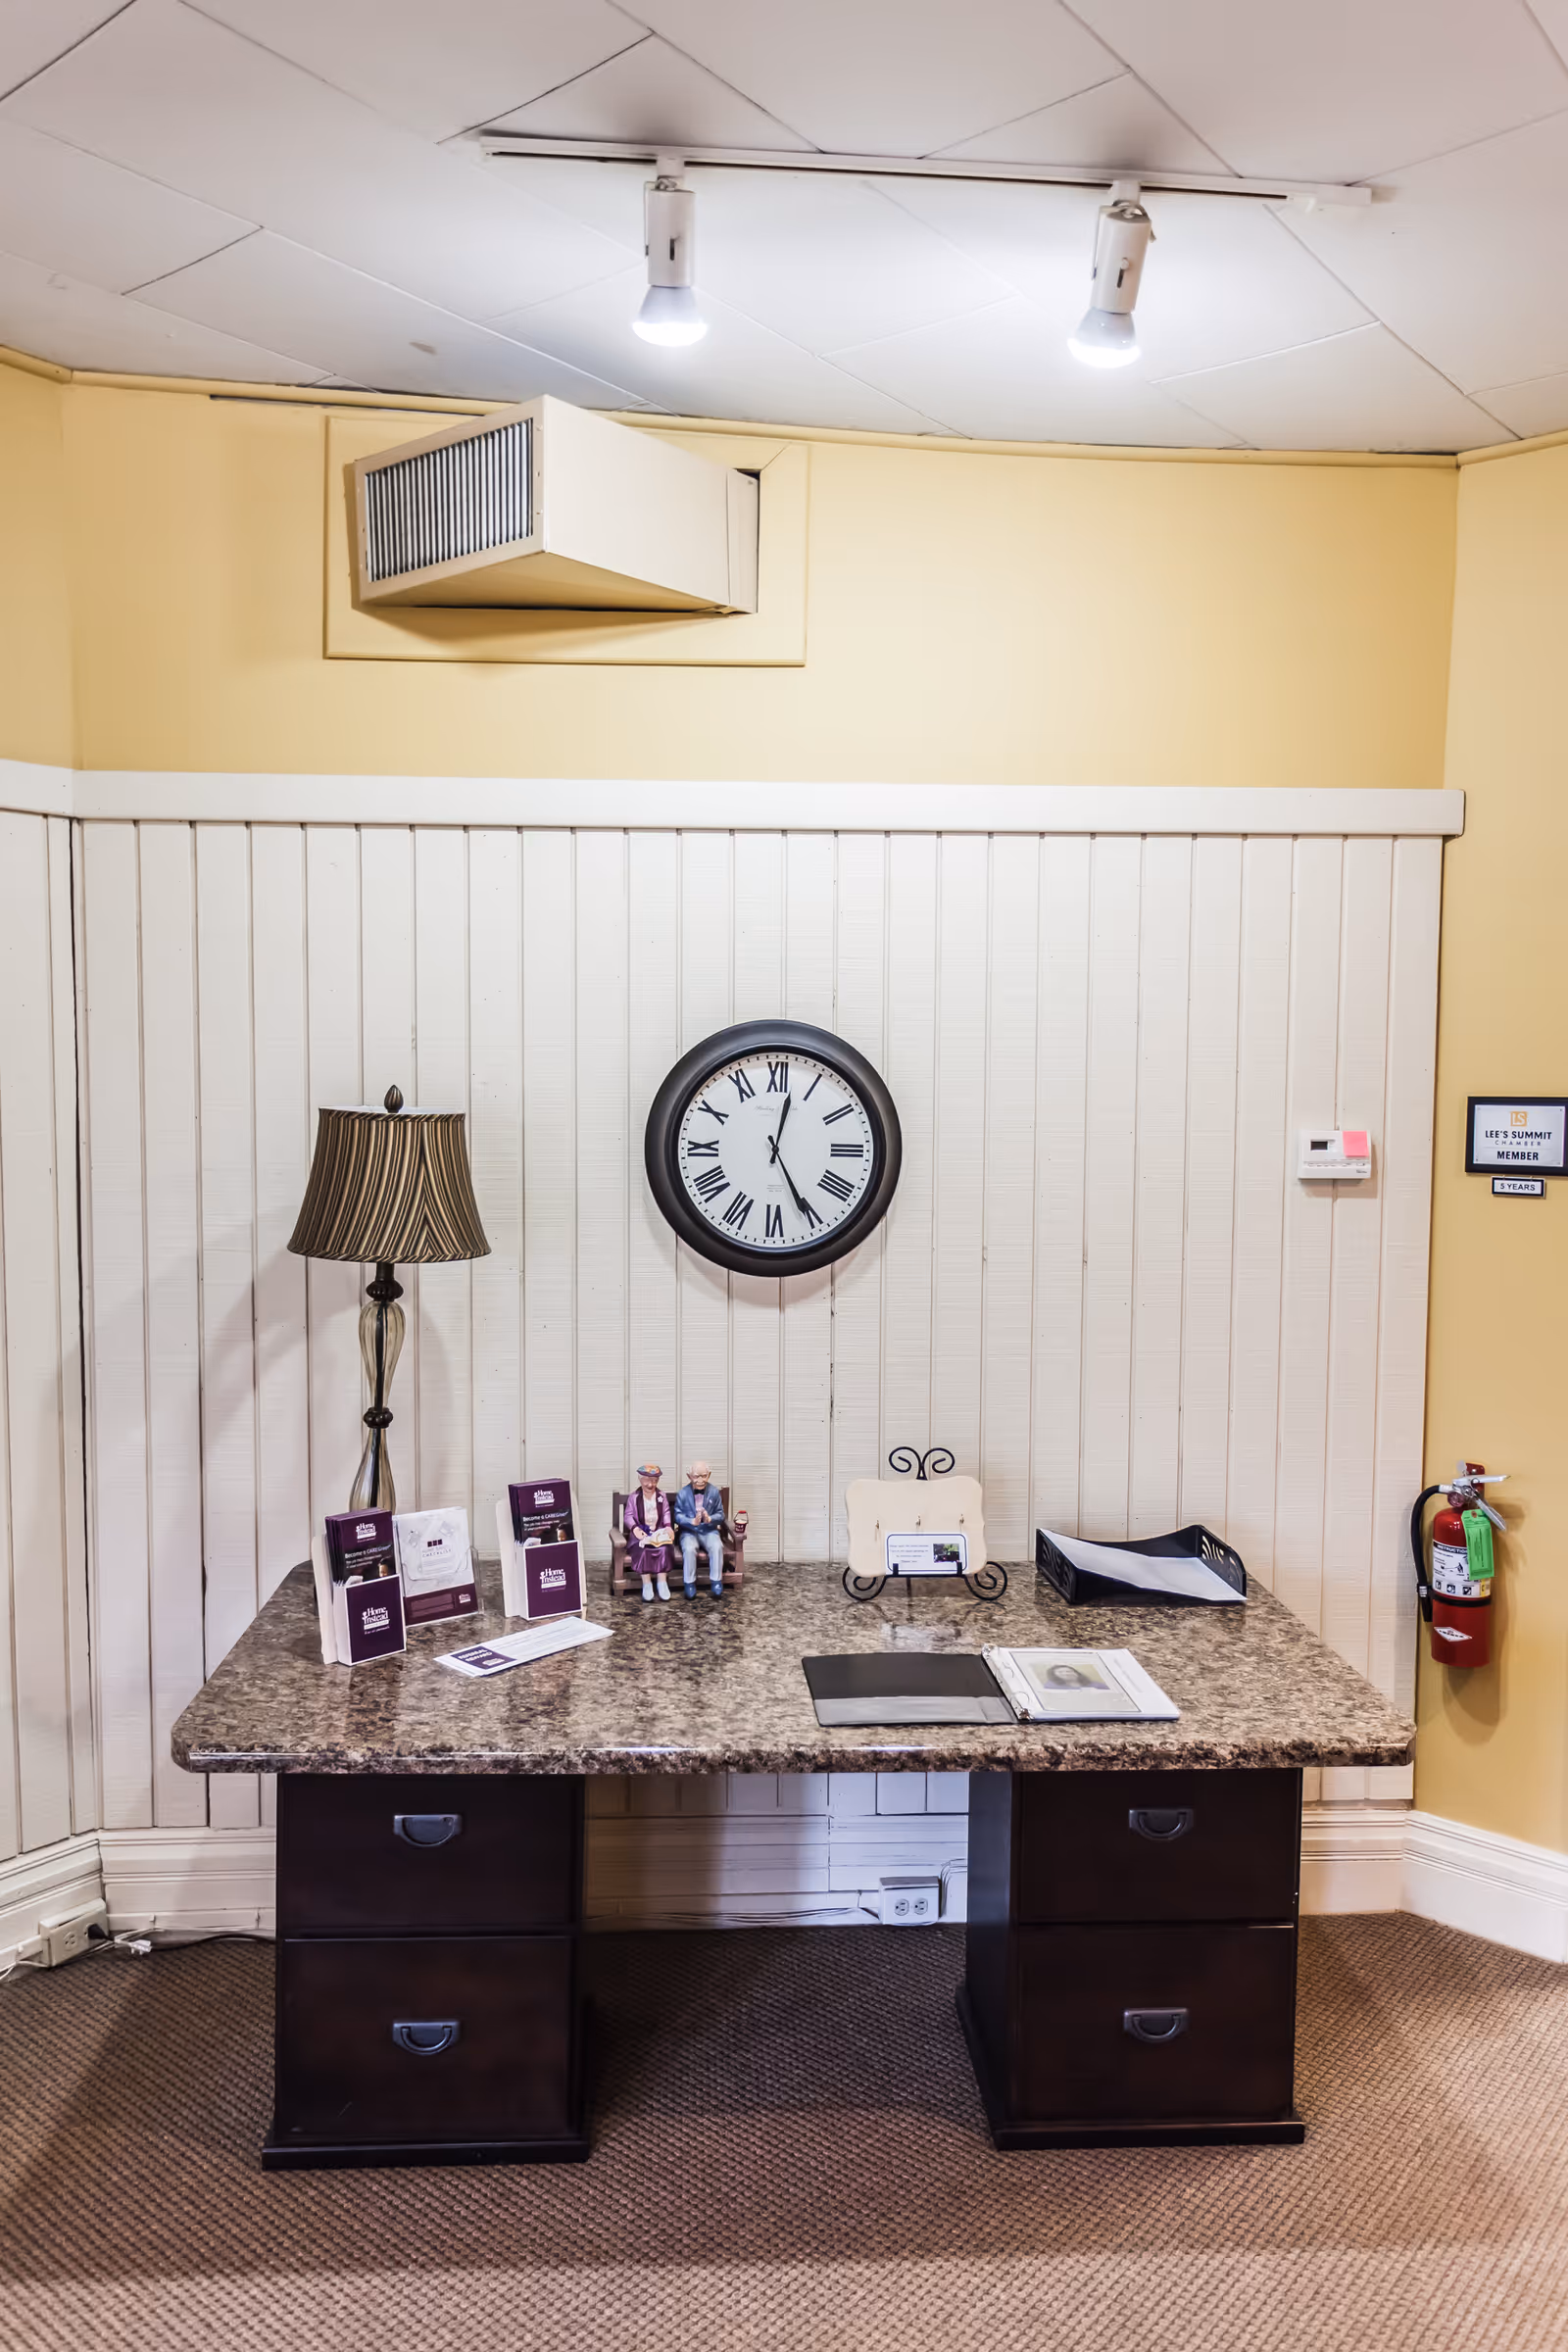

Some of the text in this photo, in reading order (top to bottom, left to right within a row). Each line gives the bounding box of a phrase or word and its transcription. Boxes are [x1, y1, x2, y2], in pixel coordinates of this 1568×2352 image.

[727, 1068, 756, 1102] XI
[766, 1061, 789, 1093] XII
[697, 1100, 729, 1126] X
[1485, 1130, 1552, 1140] LEE'S SUMMIT
[687, 1140, 719, 1157] IX
[830, 1143, 864, 1157] III
[1496, 1151, 1540, 1161] MEMBER
[693, 1164, 731, 1203] VIII
[1506, 1183, 1536, 1192] YEARS
[721, 1190, 755, 1231] VII
[764, 1203, 784, 1238] VI
[545, 1568, 564, 1577] Home
[368, 1607, 387, 1617] Home
